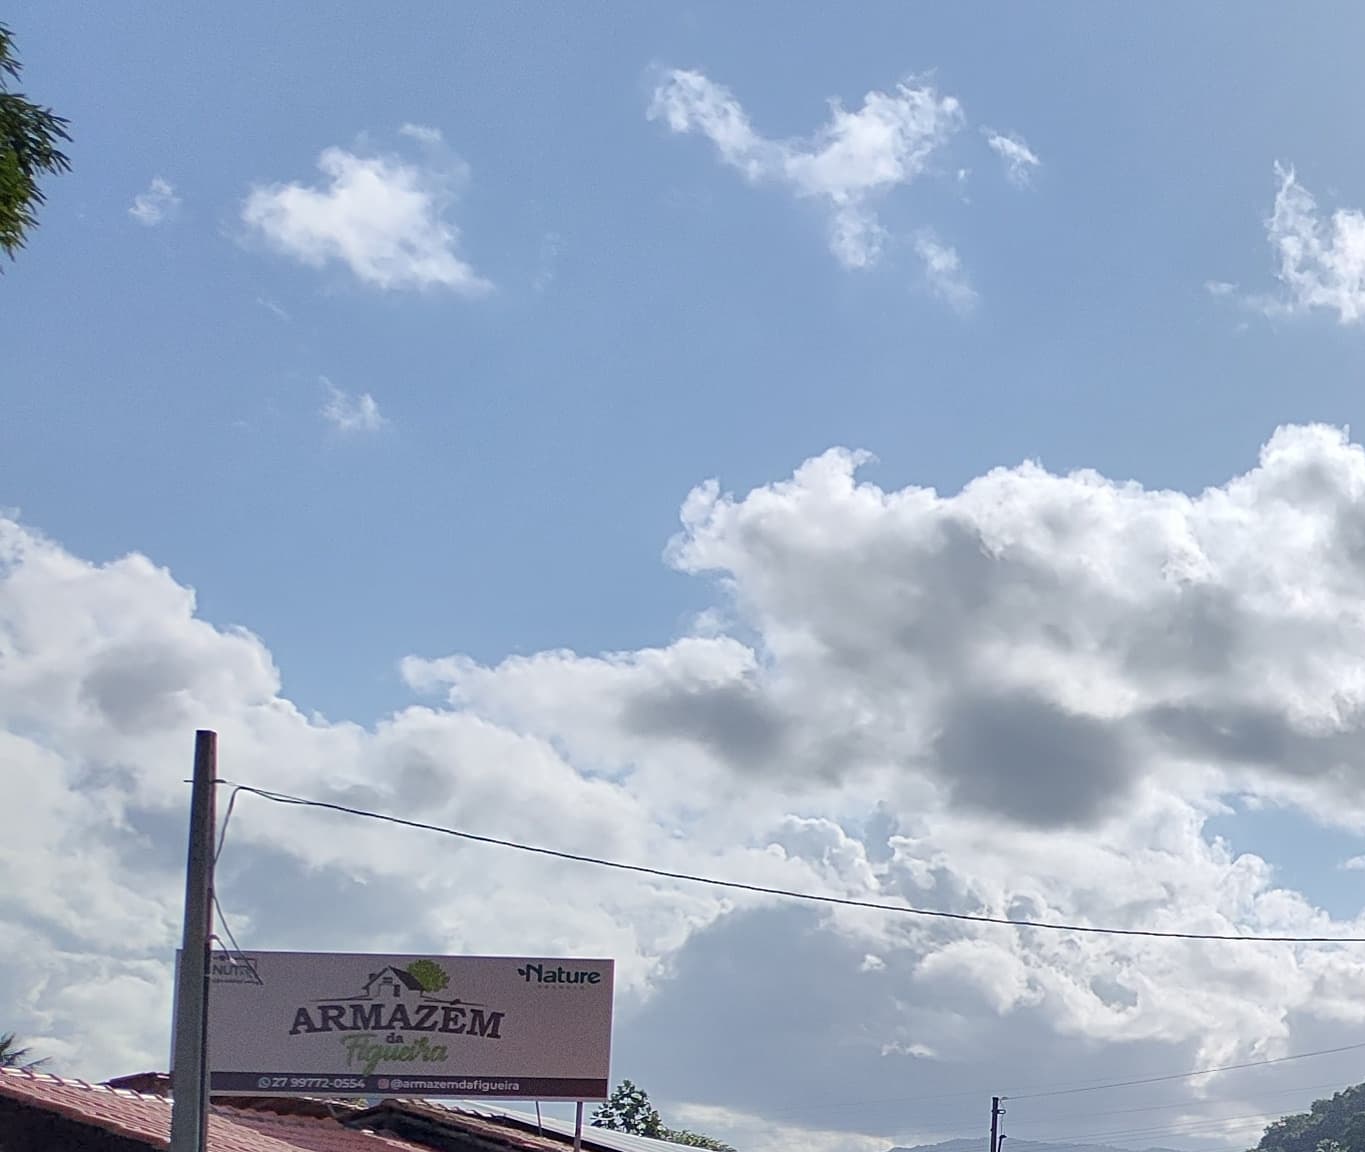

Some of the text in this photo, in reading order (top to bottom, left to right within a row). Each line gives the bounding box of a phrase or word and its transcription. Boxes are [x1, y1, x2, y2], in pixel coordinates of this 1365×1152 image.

[526, 964, 601, 984] Nature
[386, 1033, 404, 1044] da
[340, 1032, 449, 1076] Figueira
[271, 1078, 287, 1087] 27
[390, 1079, 520, 1092] @armazemdafigueira
